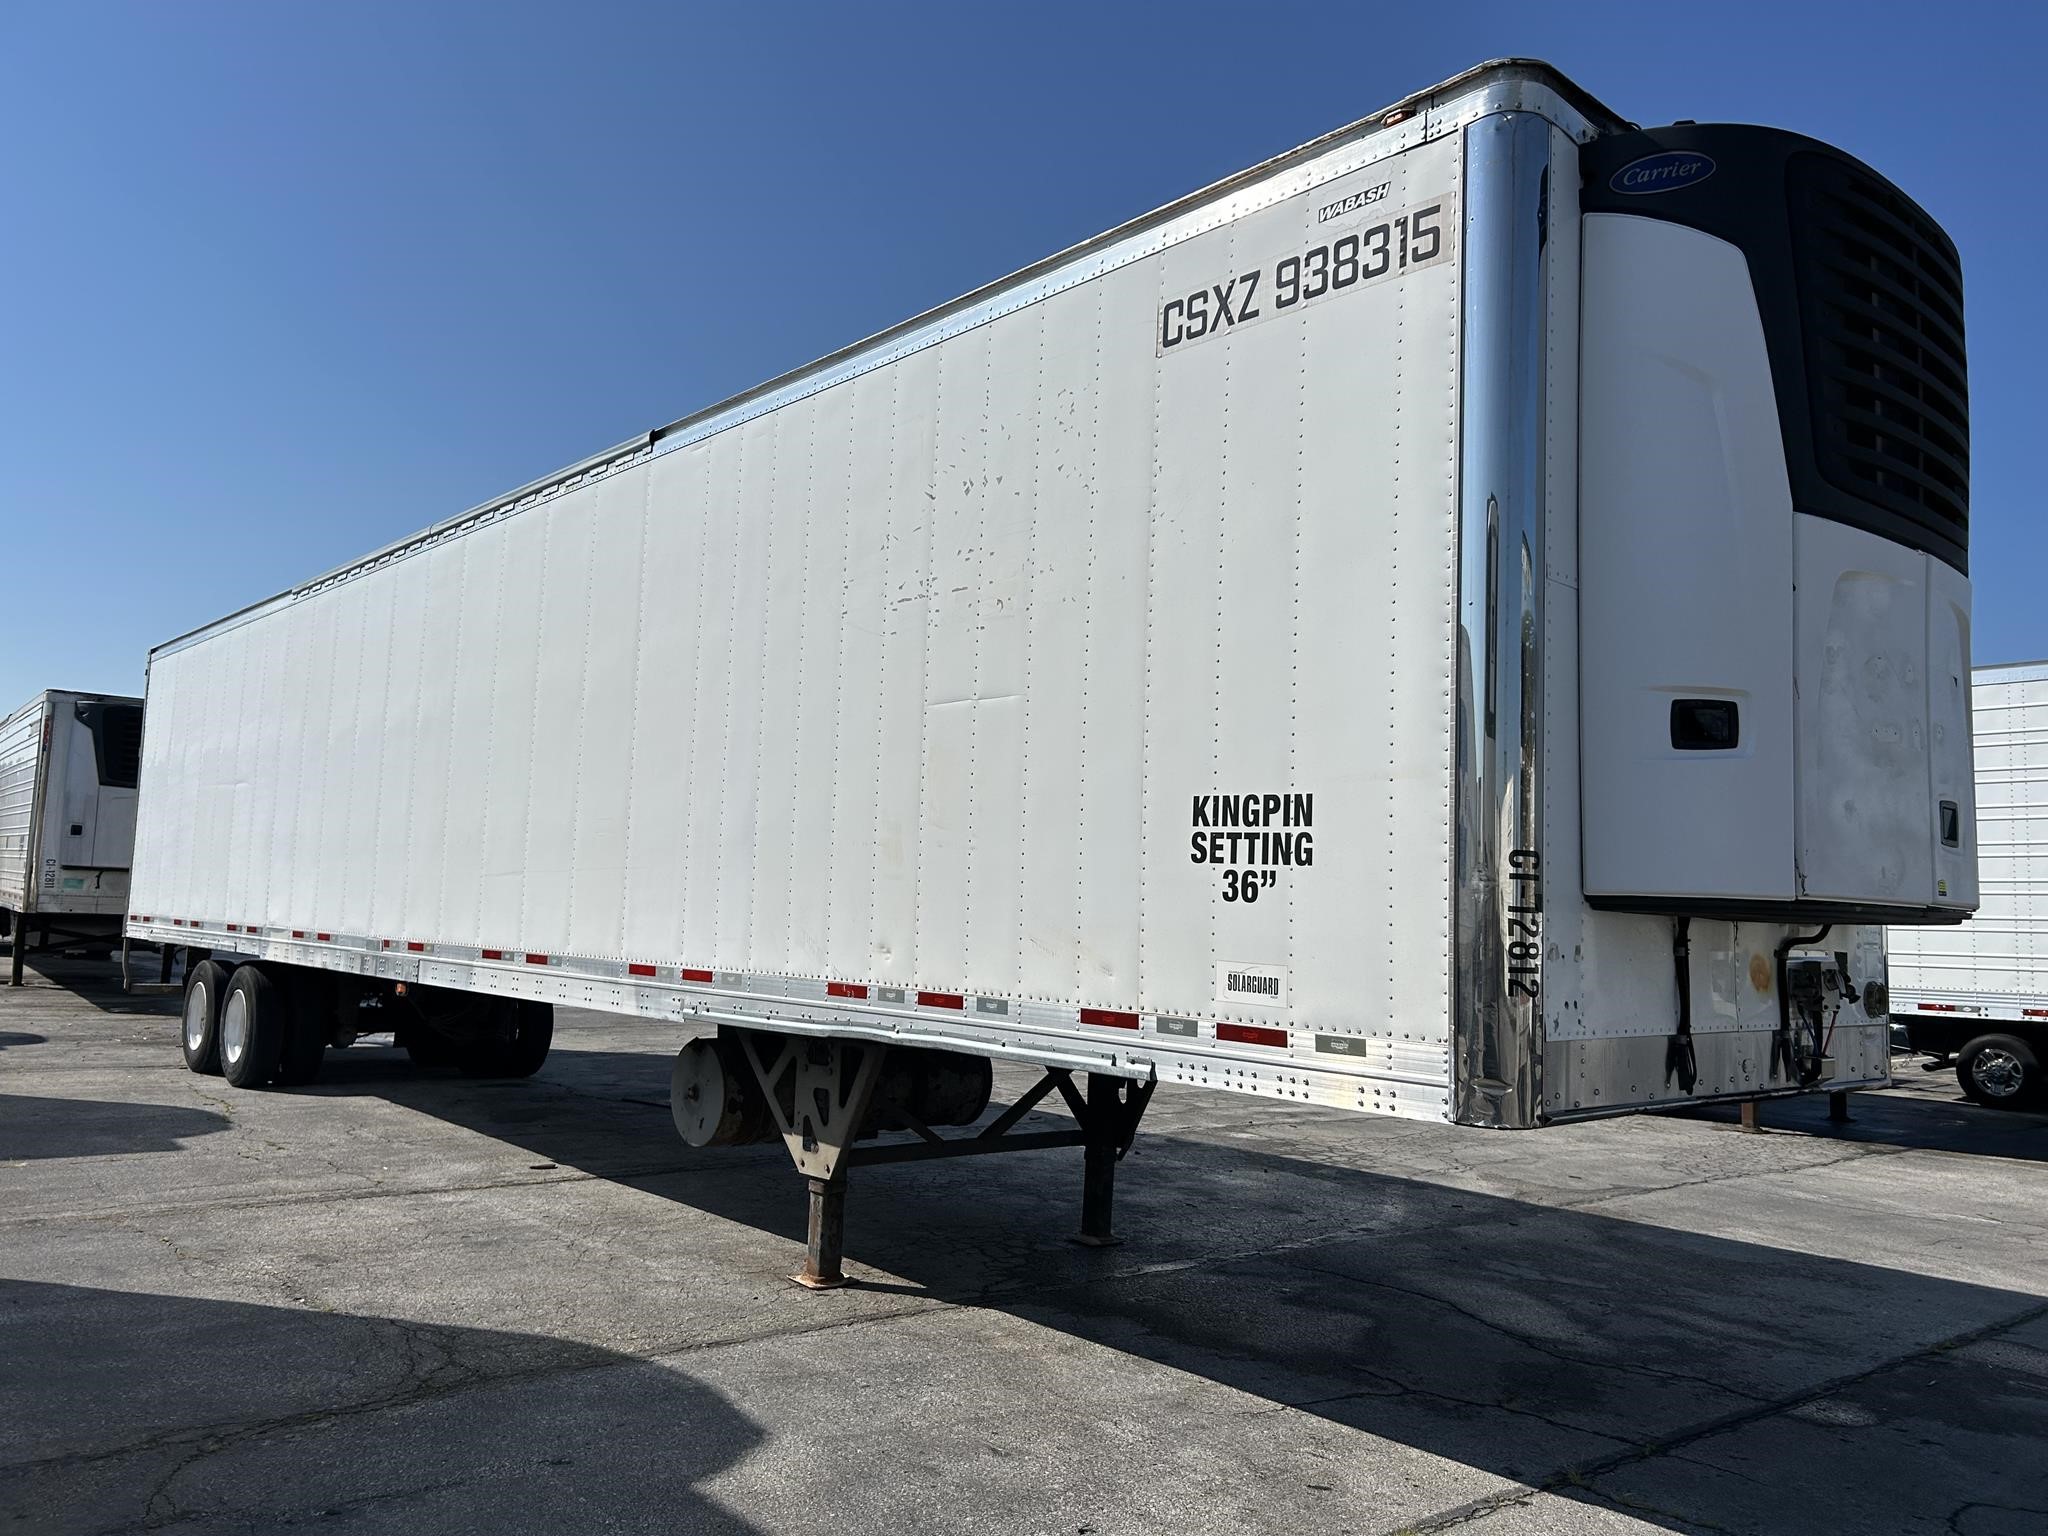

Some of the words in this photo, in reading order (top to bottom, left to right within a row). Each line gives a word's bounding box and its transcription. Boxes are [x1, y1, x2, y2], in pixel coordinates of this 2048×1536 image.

[1623, 161, 1701, 186] Carrier
[1319, 183, 1390, 222] WABASH
[1161, 269, 1261, 349] CSXZ
[1274, 203, 1441, 310] 938315
[1192, 793, 1313, 828] KINGPIN
[1190, 831, 1313, 867] SETTING
[1507, 849, 1540, 999] CI-12812
[1227, 973, 1279, 996] SOLARGUARD
